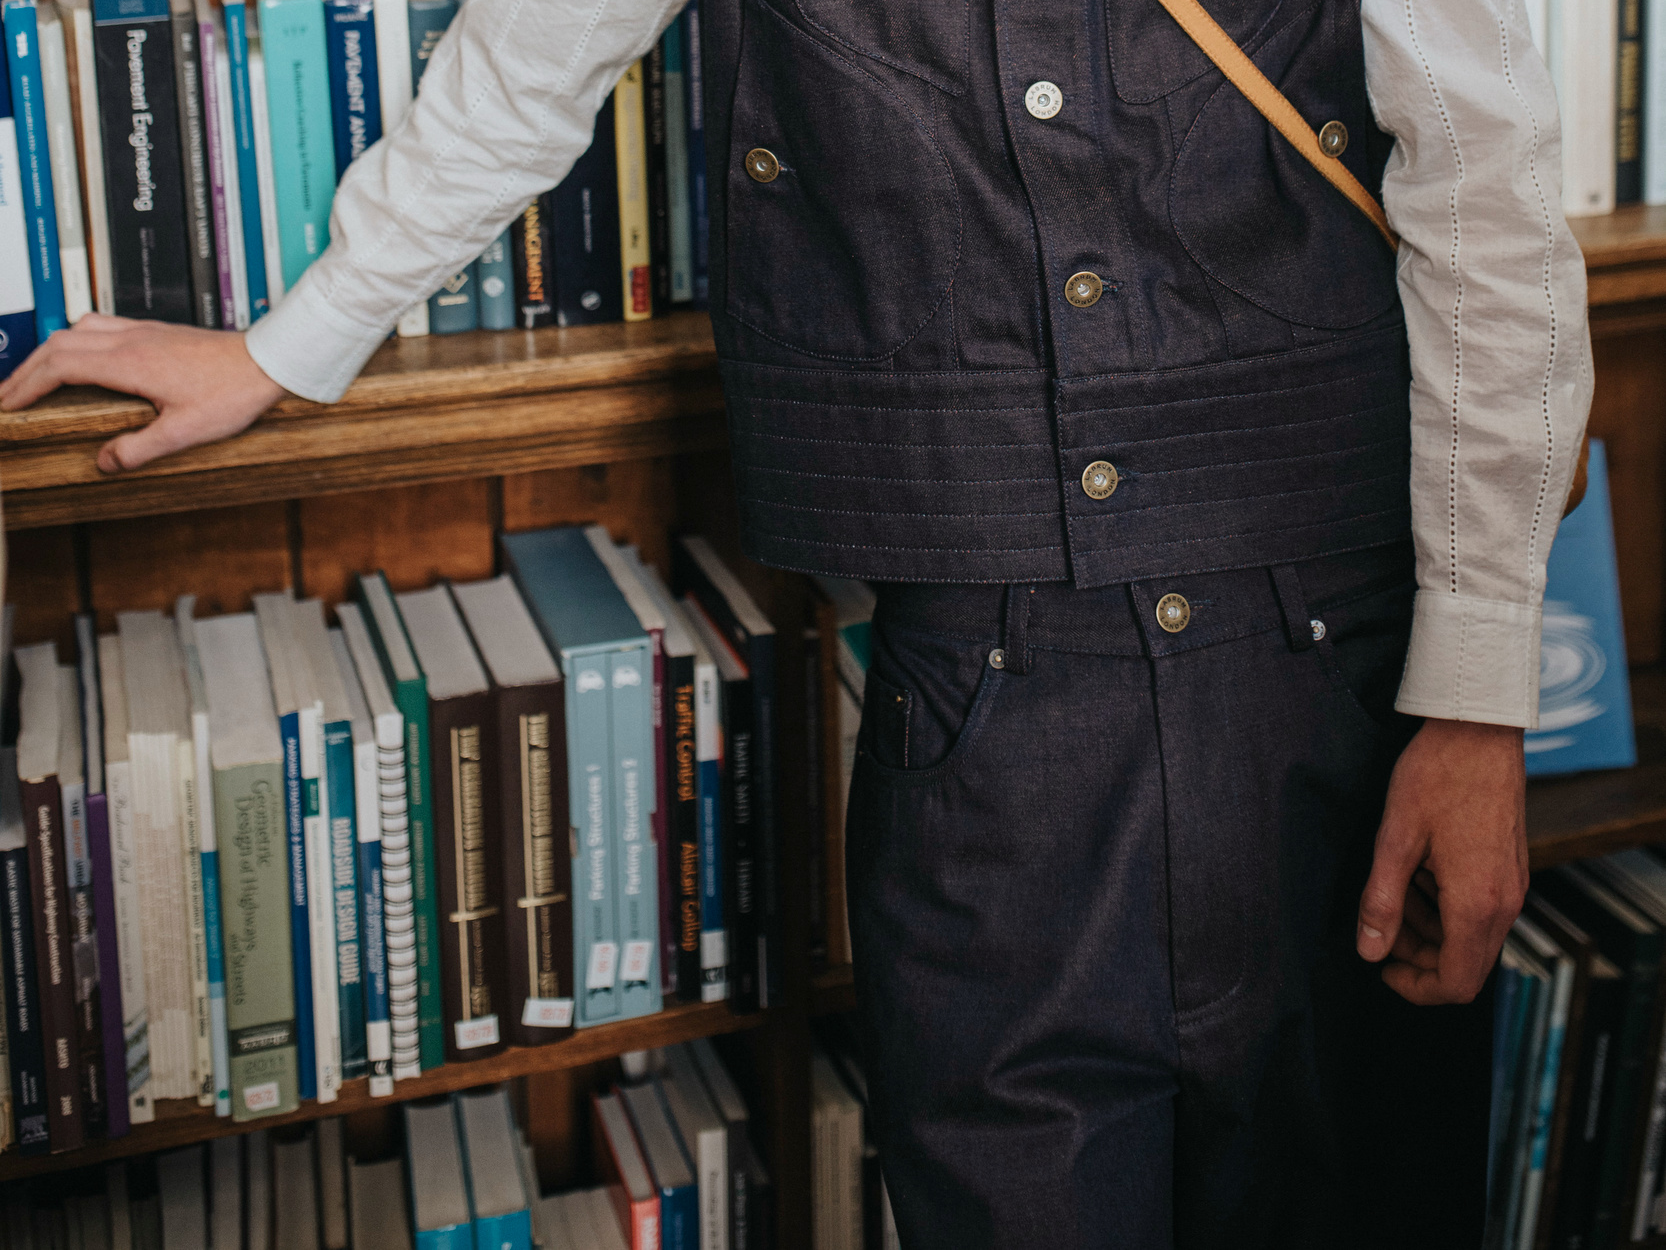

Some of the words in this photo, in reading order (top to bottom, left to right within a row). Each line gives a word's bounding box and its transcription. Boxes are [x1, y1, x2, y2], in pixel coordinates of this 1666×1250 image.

[127, 30, 150, 111] Pavement
[344, 31, 366, 114] PAVEMENT
[1029, 84, 1057, 100] LABRUM
[1030, 100, 1060, 116] LONDON
[129, 113, 156, 212] Engineering
[525, 199, 545, 302] ANAGEMENT
[1068, 274, 1097, 291] LABRUM
[1070, 288, 1100, 305] LONDON
[1085, 464, 1113, 481] LABRUM
[1087, 479, 1116, 497] LONDON
[1160, 596, 1187, 611] LABRUM
[1160, 615, 1188, 630] LONDON
[674, 685, 698, 738] Traffic
[287, 737, 300, 778] PARKING
[621, 758, 638, 769] 2
[674, 739, 697, 802] Control
[37, 806, 50, 830] Guide
[113, 795, 130, 852] Boulevard
[233, 796, 257, 857] Design
[251, 780, 274, 868] Geometric
[288, 779, 302, 834] STRATEGIES
[585, 775, 603, 847] Structures
[622, 772, 640, 842] Structures
[5, 860, 17, 889] PLASTIC
[38, 830, 54, 886] Specifications
[71, 800, 81, 818] THE
[77, 892, 89, 944] MOTORWAY
[116, 855, 132, 884] Book
[293, 844, 305, 907] MANAGEMENT
[331, 816, 356, 888] ROADSIDE
[587, 848, 607, 901] Parking
[623, 844, 642, 896] Parking
[680, 842, 699, 896] Alistair
[8, 890, 19, 914] WASTE
[43, 900, 59, 934] Highway
[237, 877, 258, 952] Highways
[334, 889, 357, 941] DESIGN
[680, 900, 701, 952] Gollop
[11, 929, 25, 975] SUSTAINABLE
[47, 935, 62, 985] Construction
[230, 934, 242, 953] and
[338, 943, 360, 987] GUIDE
[16, 976, 27, 1006] ASPHALT
[231, 954, 247, 1006] Streets
[19, 1007, 29, 1031] ROADS
[57, 1038, 69, 1069] AASHTO
